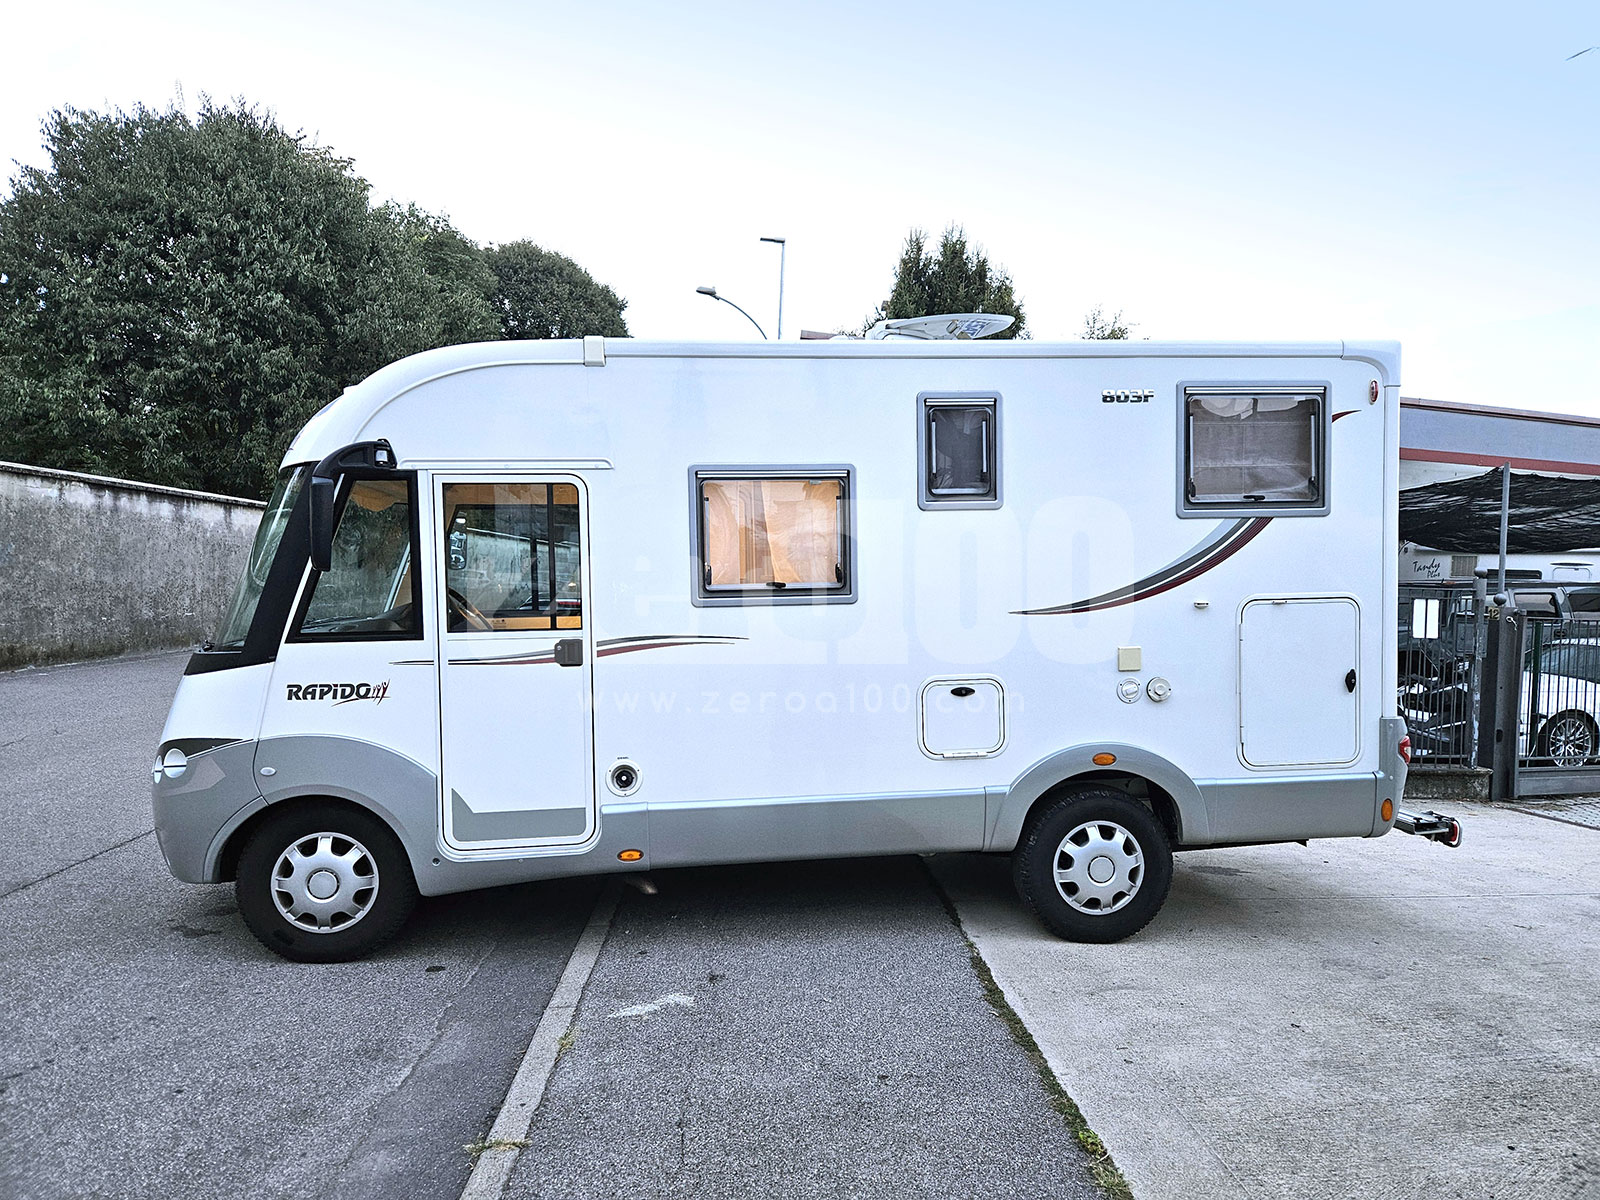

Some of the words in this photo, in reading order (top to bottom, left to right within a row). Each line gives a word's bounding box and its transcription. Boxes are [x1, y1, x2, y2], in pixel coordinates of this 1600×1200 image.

[1102, 388, 1154, 403] 803F
[1412, 558, 1441, 573] Tandy
[1488, 608, 1500, 620] 12
